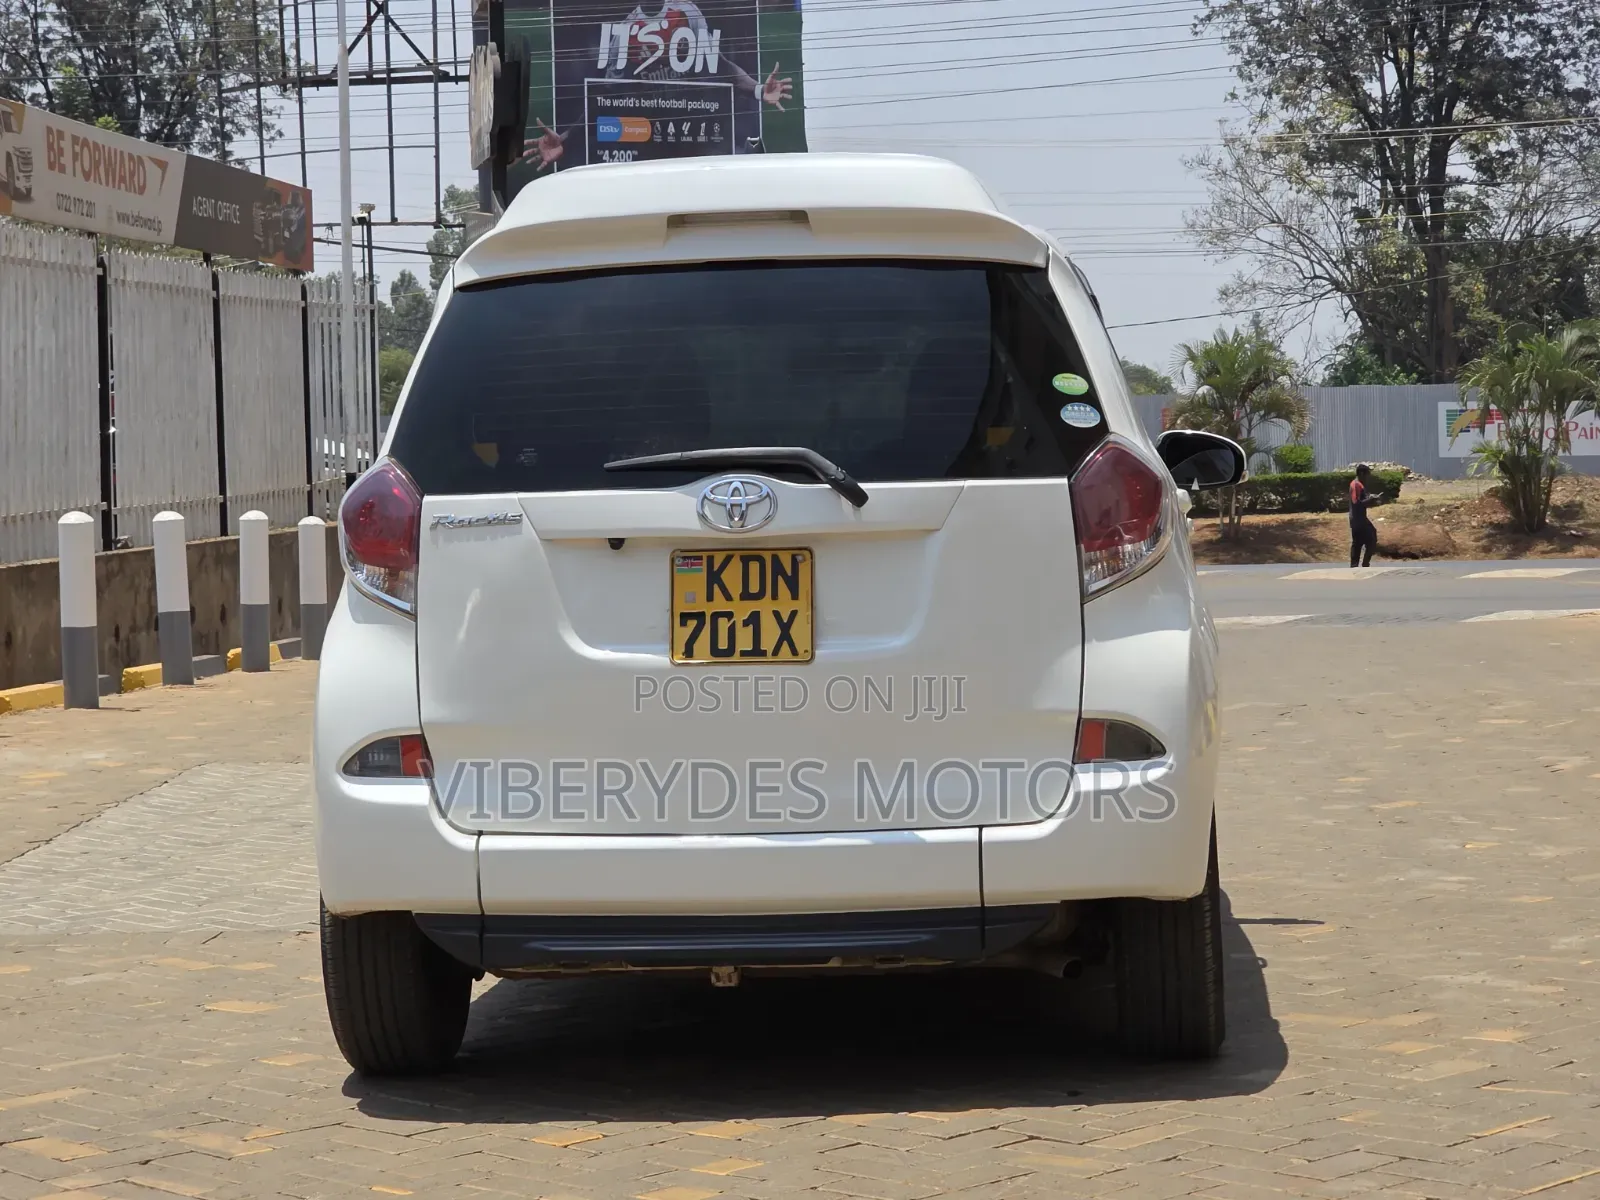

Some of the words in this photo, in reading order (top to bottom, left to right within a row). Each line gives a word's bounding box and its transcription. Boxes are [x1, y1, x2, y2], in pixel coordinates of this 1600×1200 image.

[669, 27, 721, 74] ON
[597, 97, 611, 107] The
[612, 98, 640, 107] world's
[641, 98, 657, 108] best
[658, 98, 686, 109] football
[688, 101, 719, 112] package
[46, 125, 66, 175] BE
[71, 133, 147, 195] FORWARD
[192, 196, 215, 219] AGENT
[217, 200, 240, 224] OFFICE
[706, 554, 800, 602] KDN
[679, 609, 799, 659] 701X
